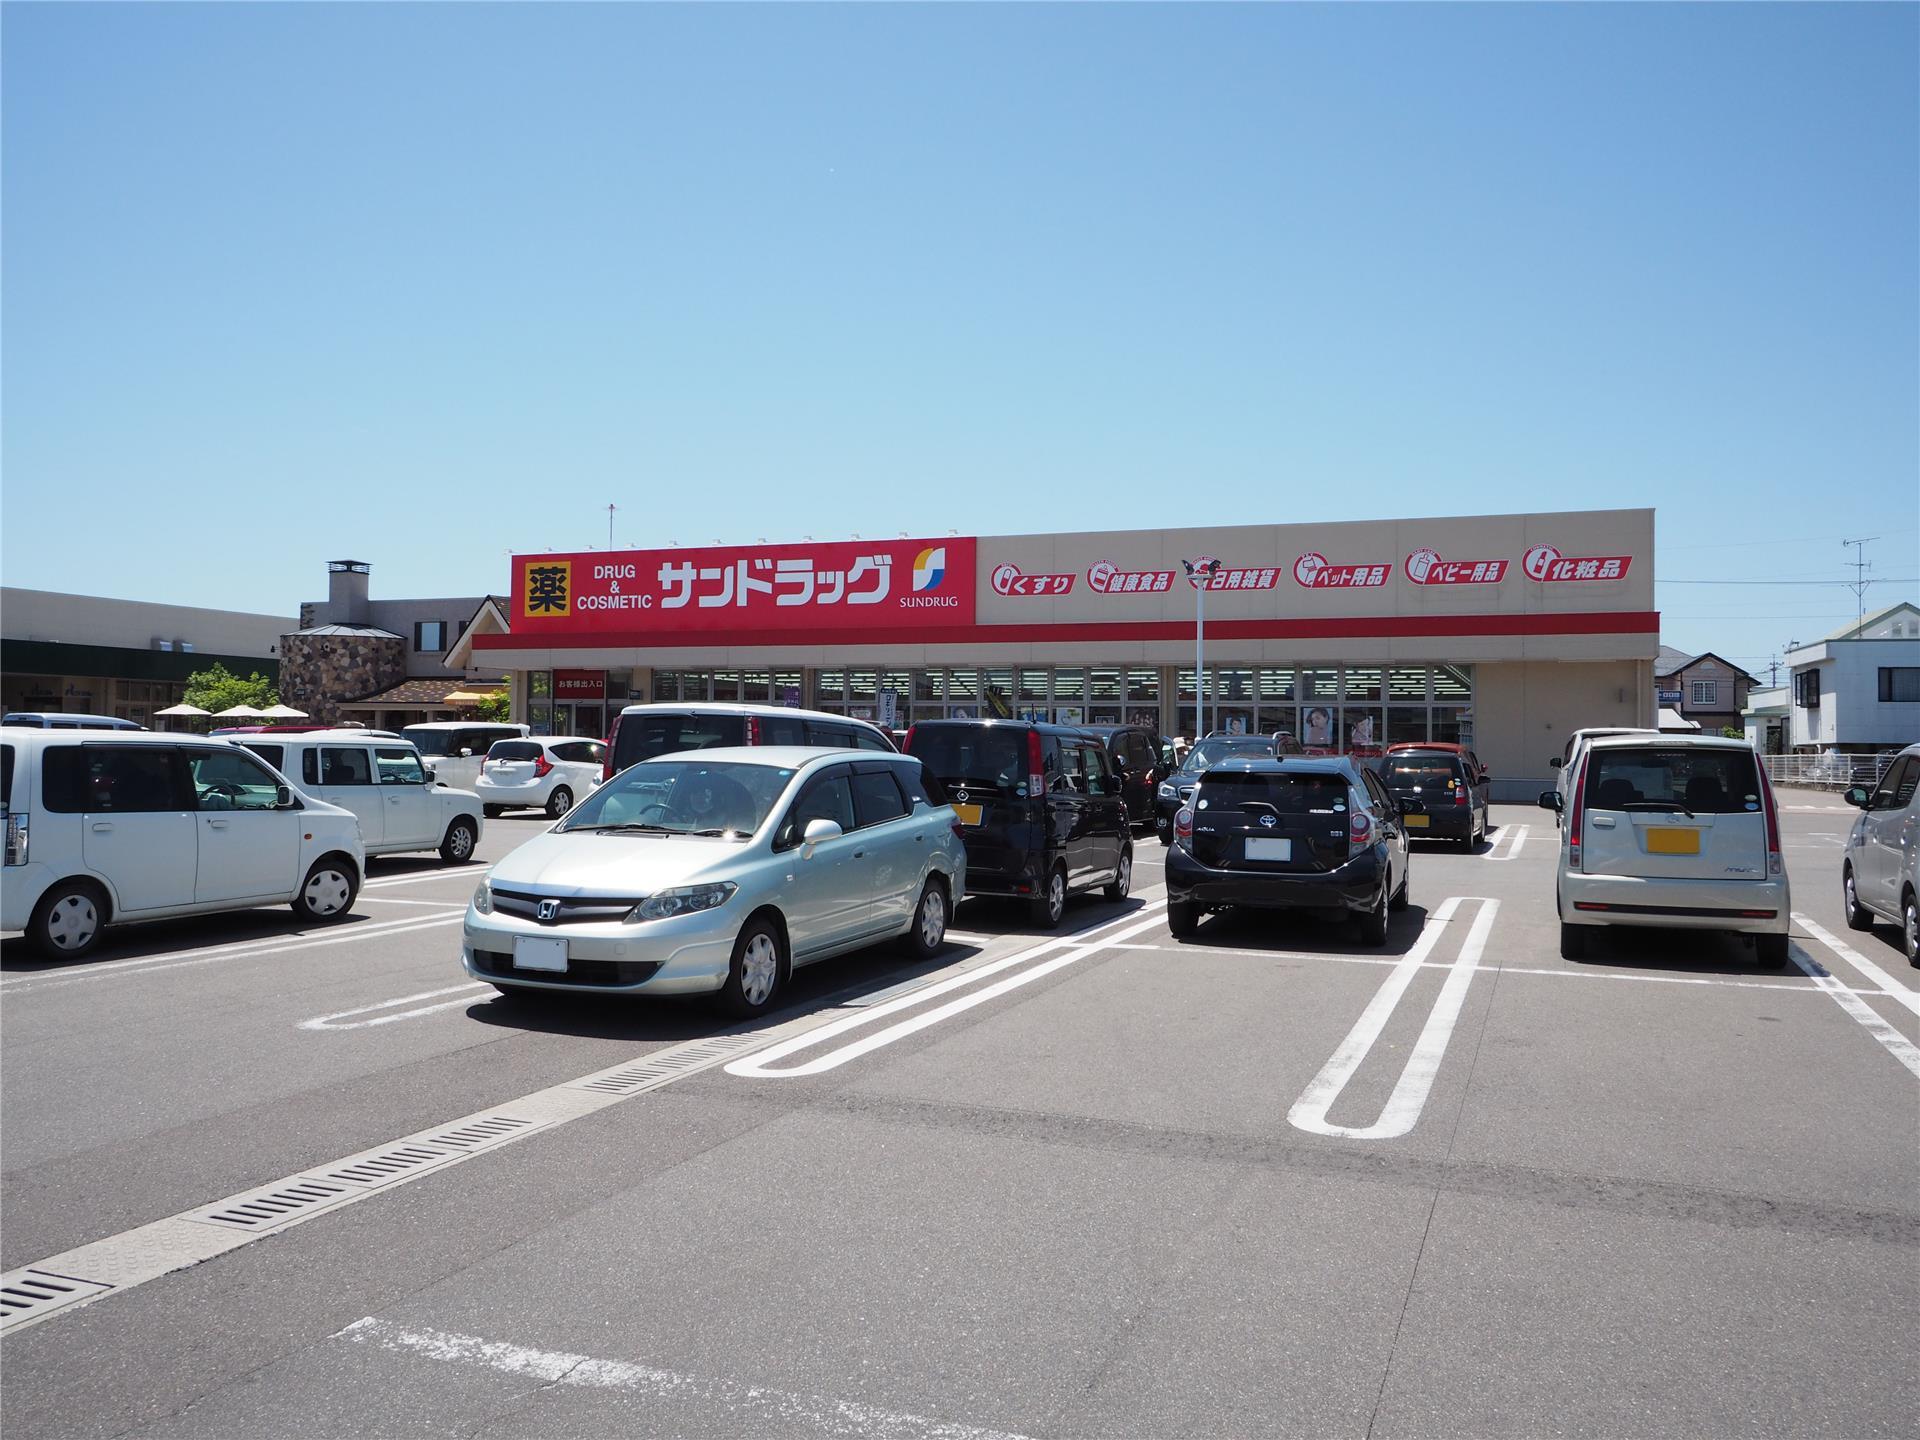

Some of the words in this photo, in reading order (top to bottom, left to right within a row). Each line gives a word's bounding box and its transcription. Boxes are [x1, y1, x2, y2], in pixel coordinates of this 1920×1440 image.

[594, 564, 636, 579] DRUG
[1317, 566, 1385, 586] ペット用品
[1431, 562, 1501, 582] ベビー用品
[1551, 559, 1621, 579] 化粧品
[609, 580, 621, 594] &
[657, 554, 892, 609] サンドラッグ
[1013, 576, 1068, 594] くすり
[1108, 573, 1169, 592] 健康食品
[1211, 569, 1275, 589] 日用雑貨
[528, 566, 567, 612] 薬
[577, 594, 652, 610] COSMETIC
[900, 595, 958, 608] SUNDRUG
[558, 679, 603, 688] お客様出入口
